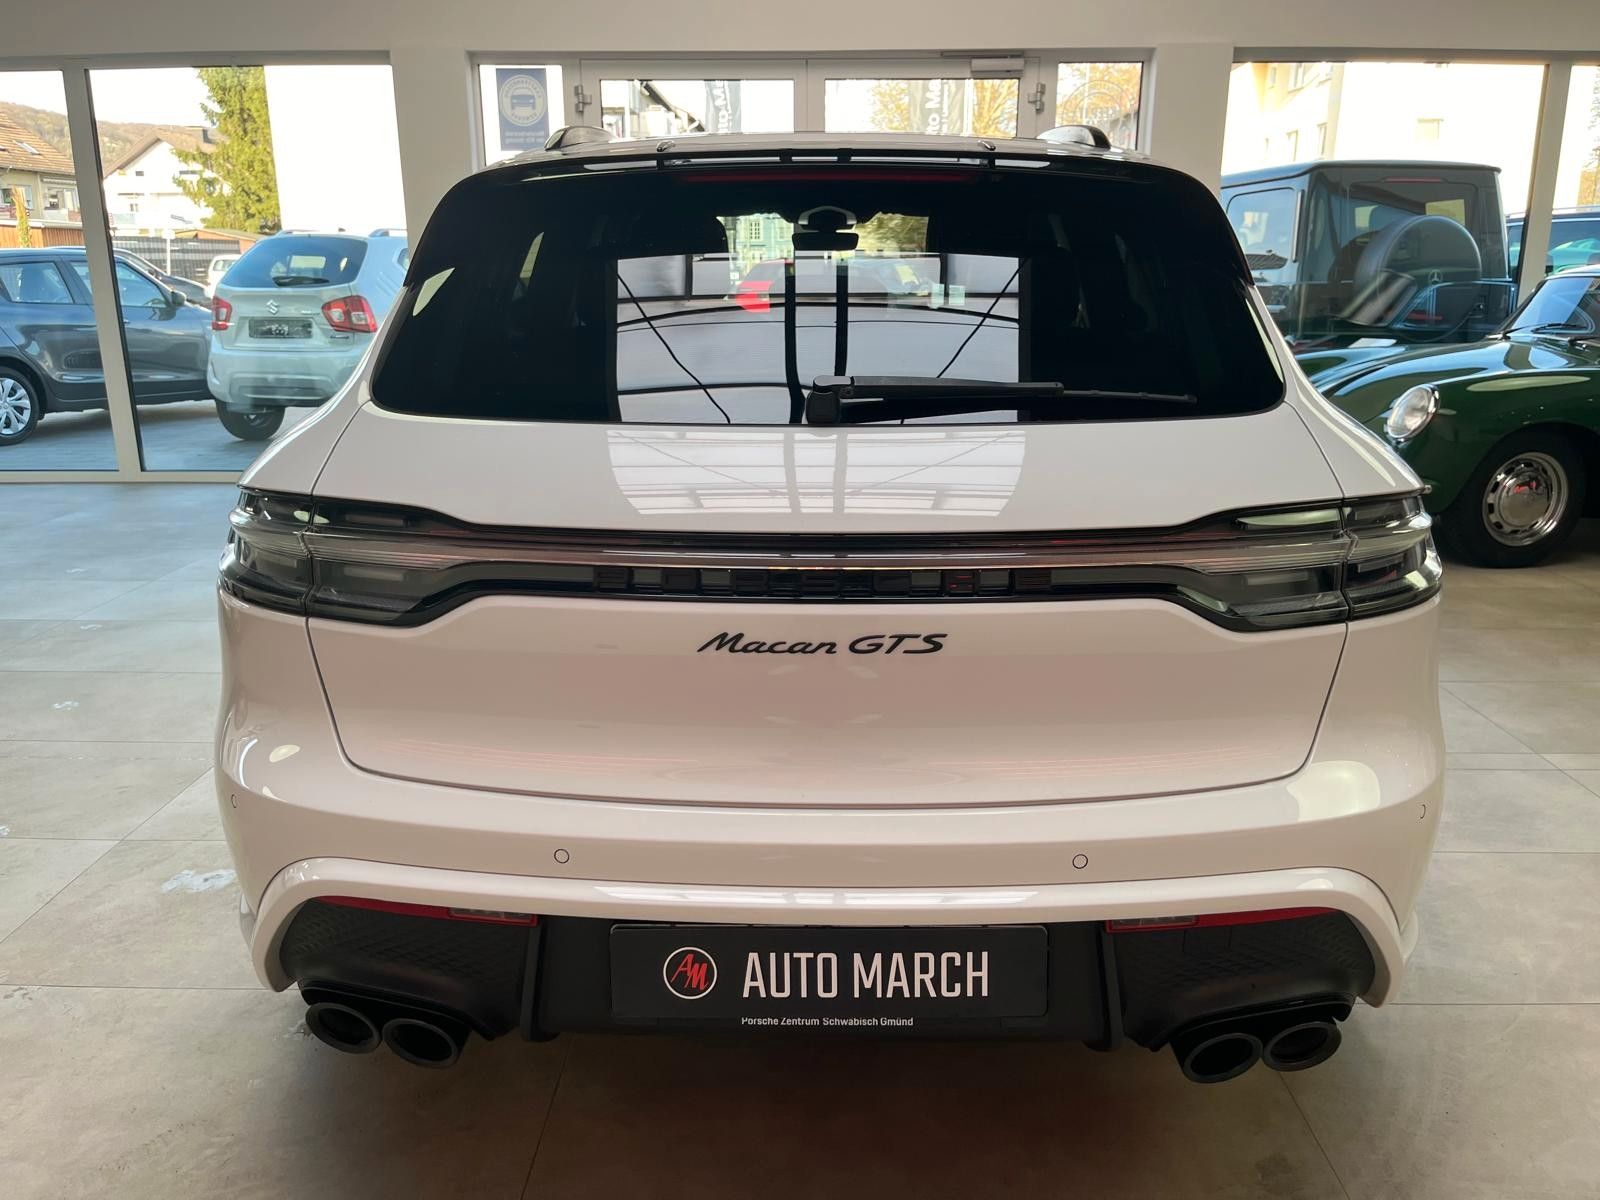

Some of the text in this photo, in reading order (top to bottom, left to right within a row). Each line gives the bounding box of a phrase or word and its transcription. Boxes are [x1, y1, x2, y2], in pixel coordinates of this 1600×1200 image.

[697, 632, 948, 654] Macan GTS
[742, 951, 989, 998] AUTO MARCH
[741, 1016, 779, 1026] Porsche
[780, 1017, 820, 1026] Zentrum
